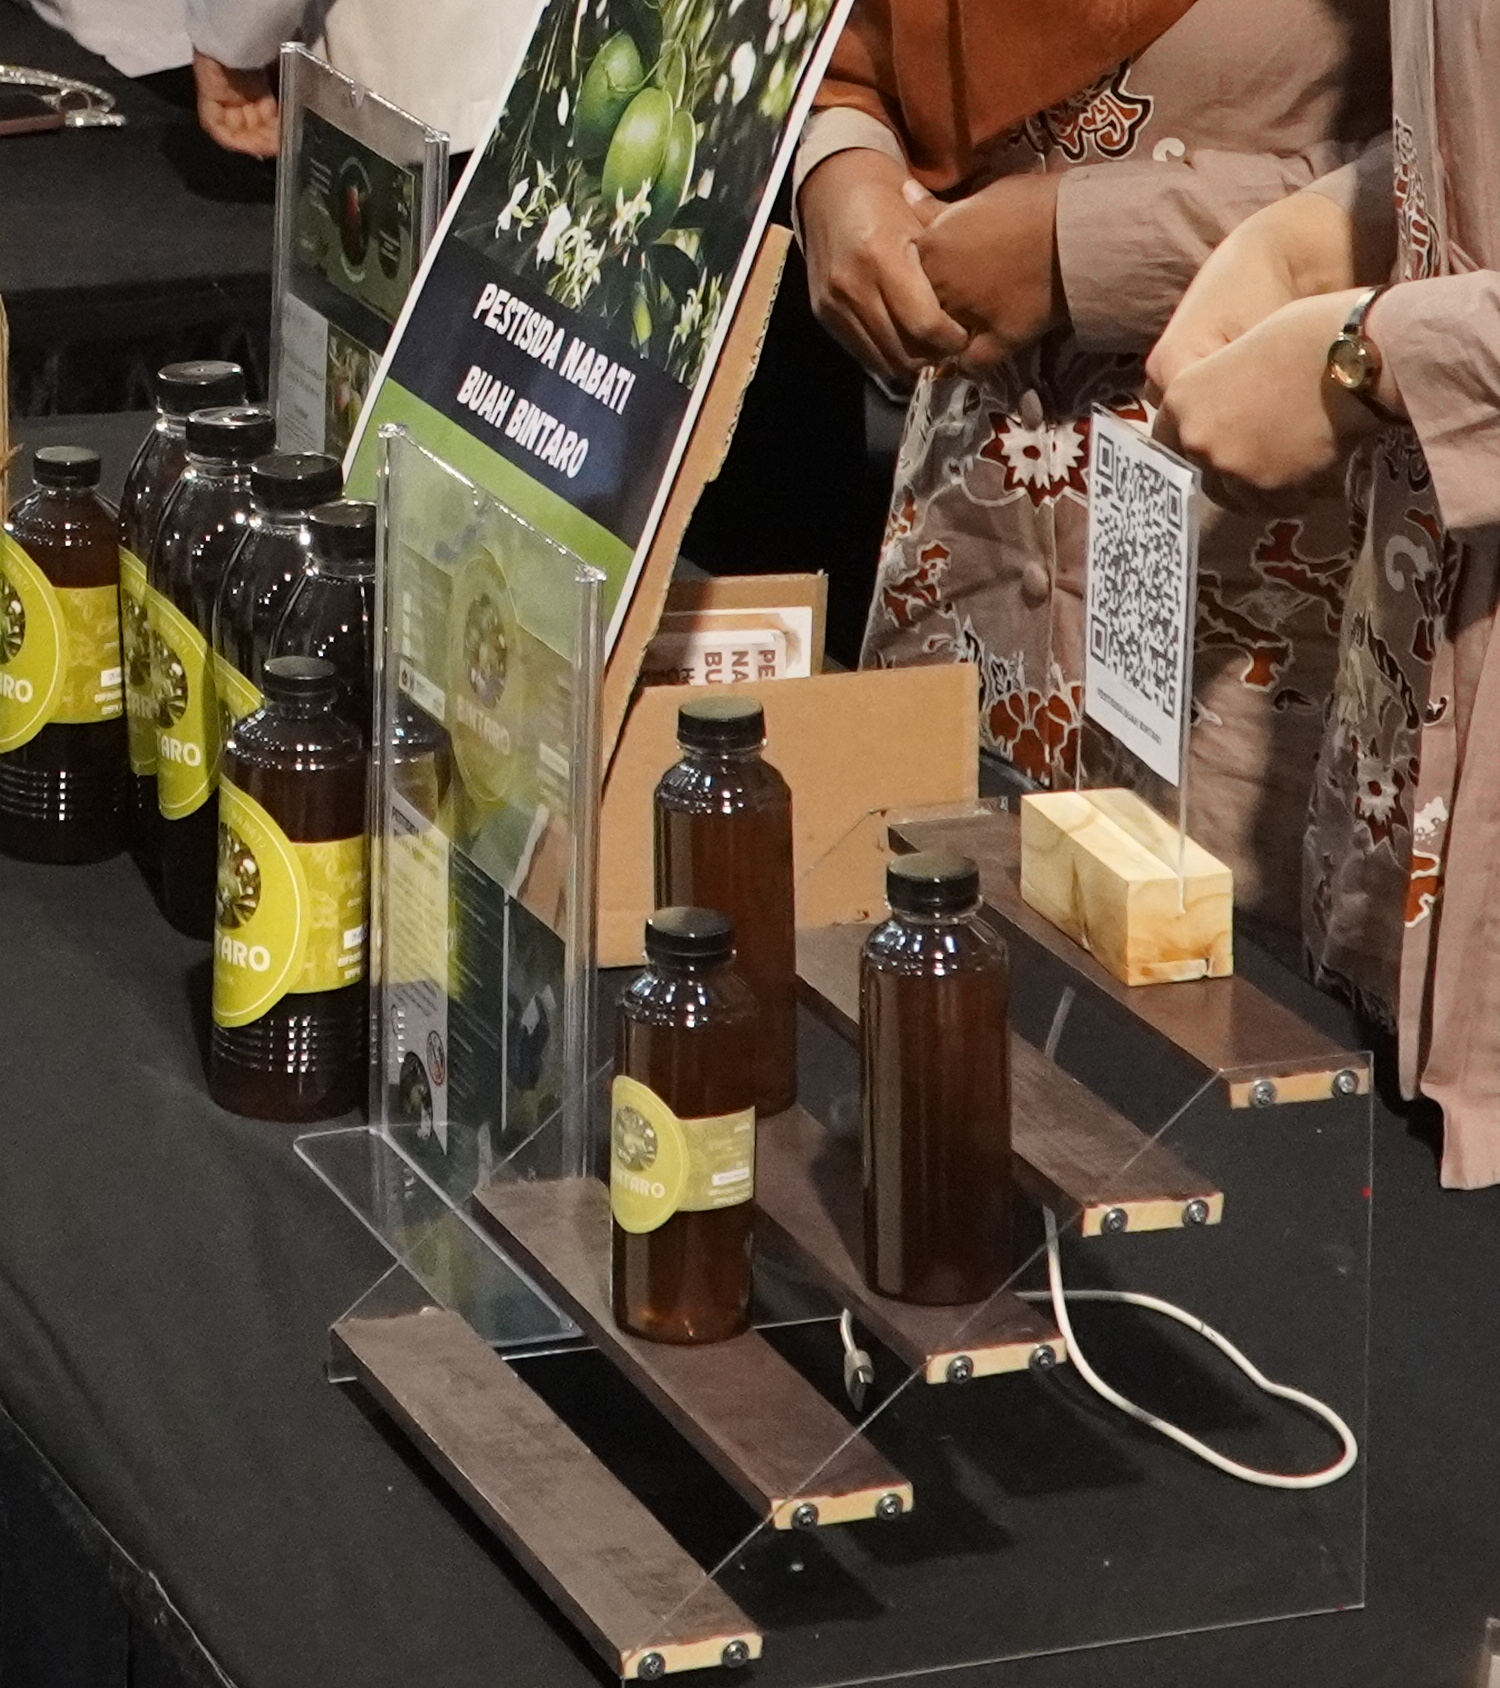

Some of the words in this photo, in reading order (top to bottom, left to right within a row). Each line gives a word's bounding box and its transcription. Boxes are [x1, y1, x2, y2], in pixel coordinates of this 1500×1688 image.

[472, 282, 566, 370] PESTISIDA
[558, 336, 637, 416] NABATI
[456, 364, 516, 429] BUAH
[503, 397, 590, 480] BINTARO
